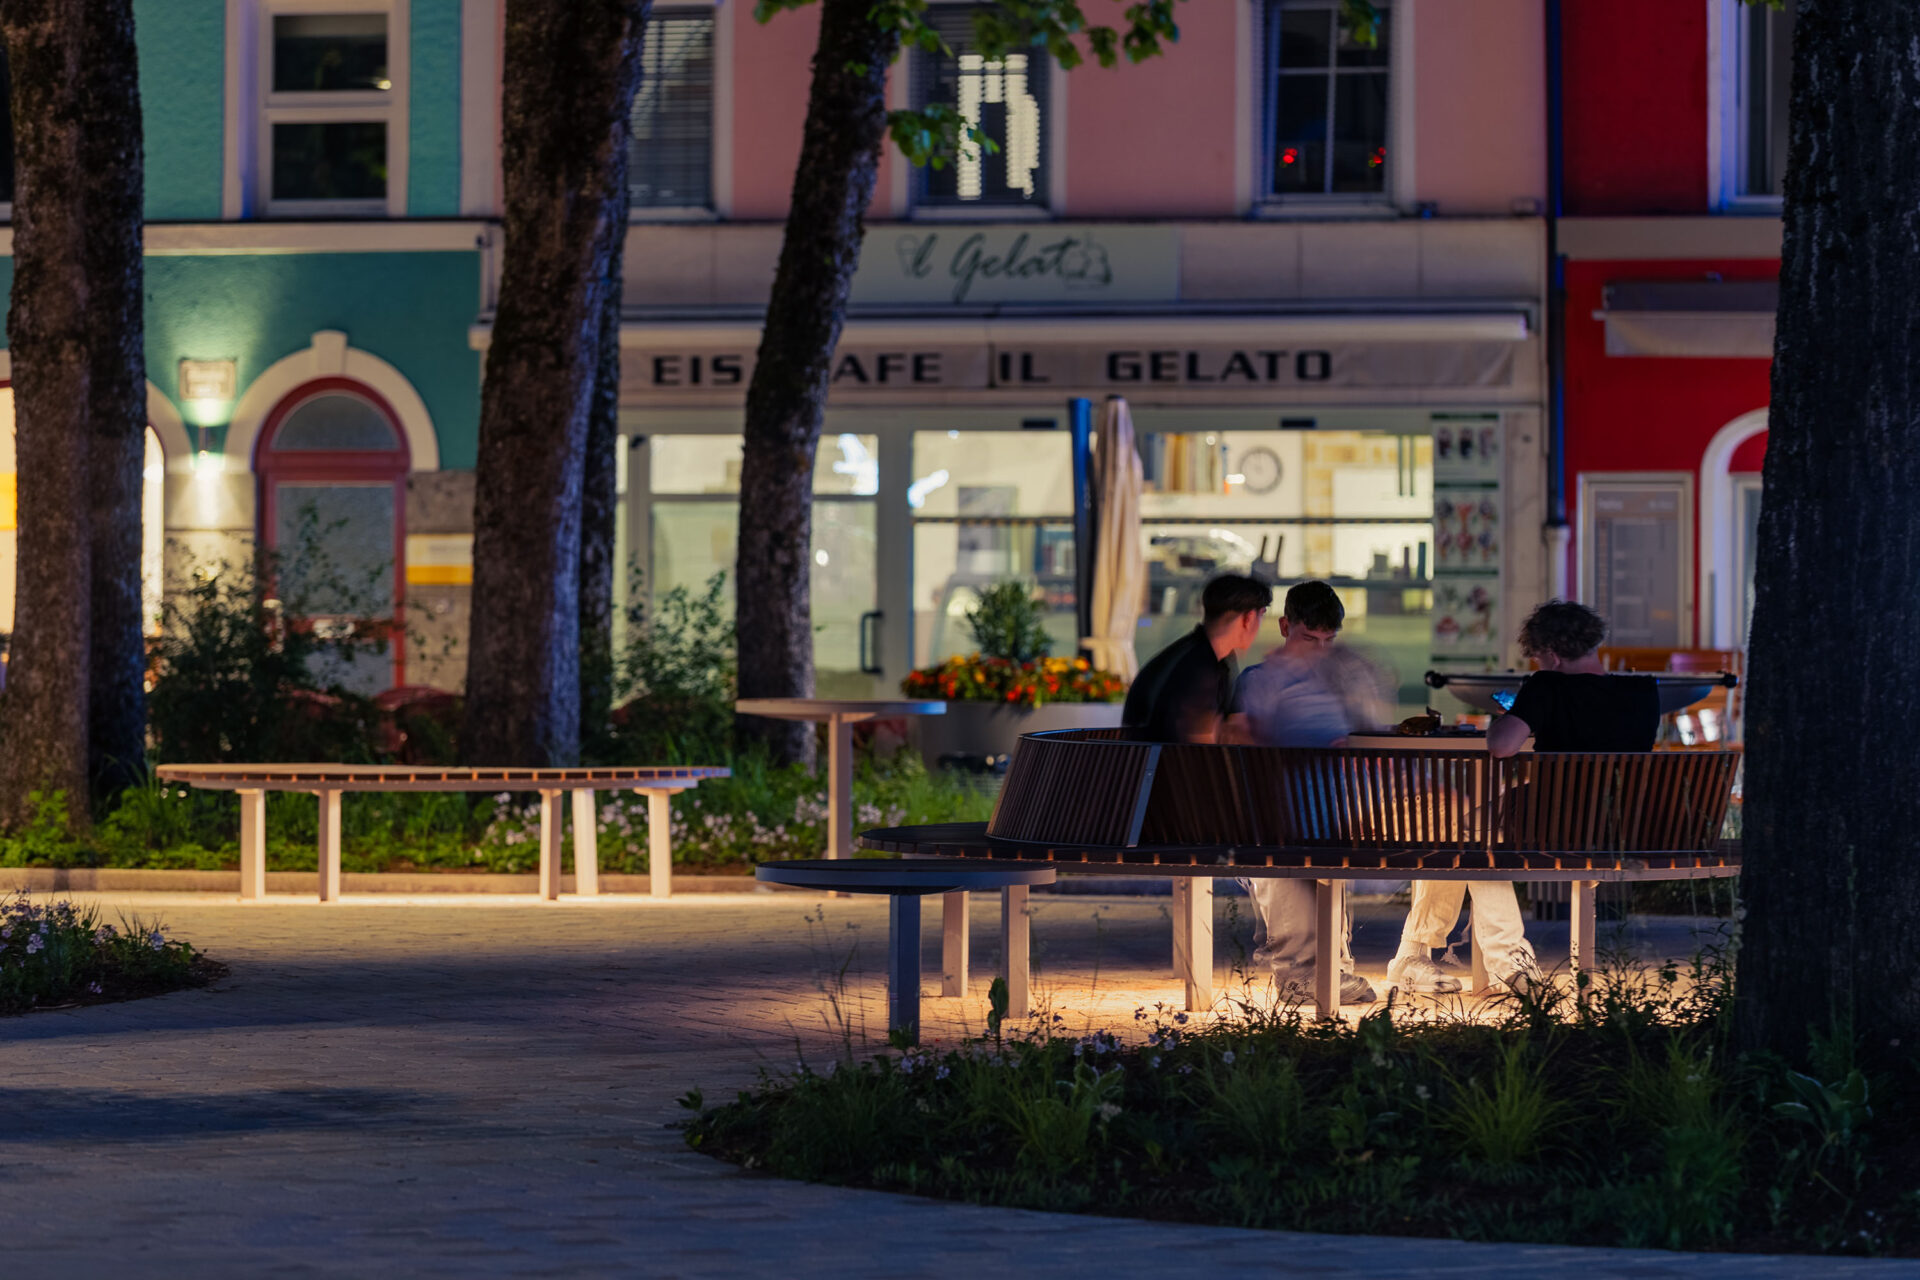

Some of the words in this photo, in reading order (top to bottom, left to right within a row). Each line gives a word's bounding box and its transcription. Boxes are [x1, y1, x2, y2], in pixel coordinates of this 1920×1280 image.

[652, 354, 743, 386] EIS
[832, 352, 943, 384] AFE
[1001, 352, 1051, 383] IL
[1106, 349, 1333, 383] GELATO
